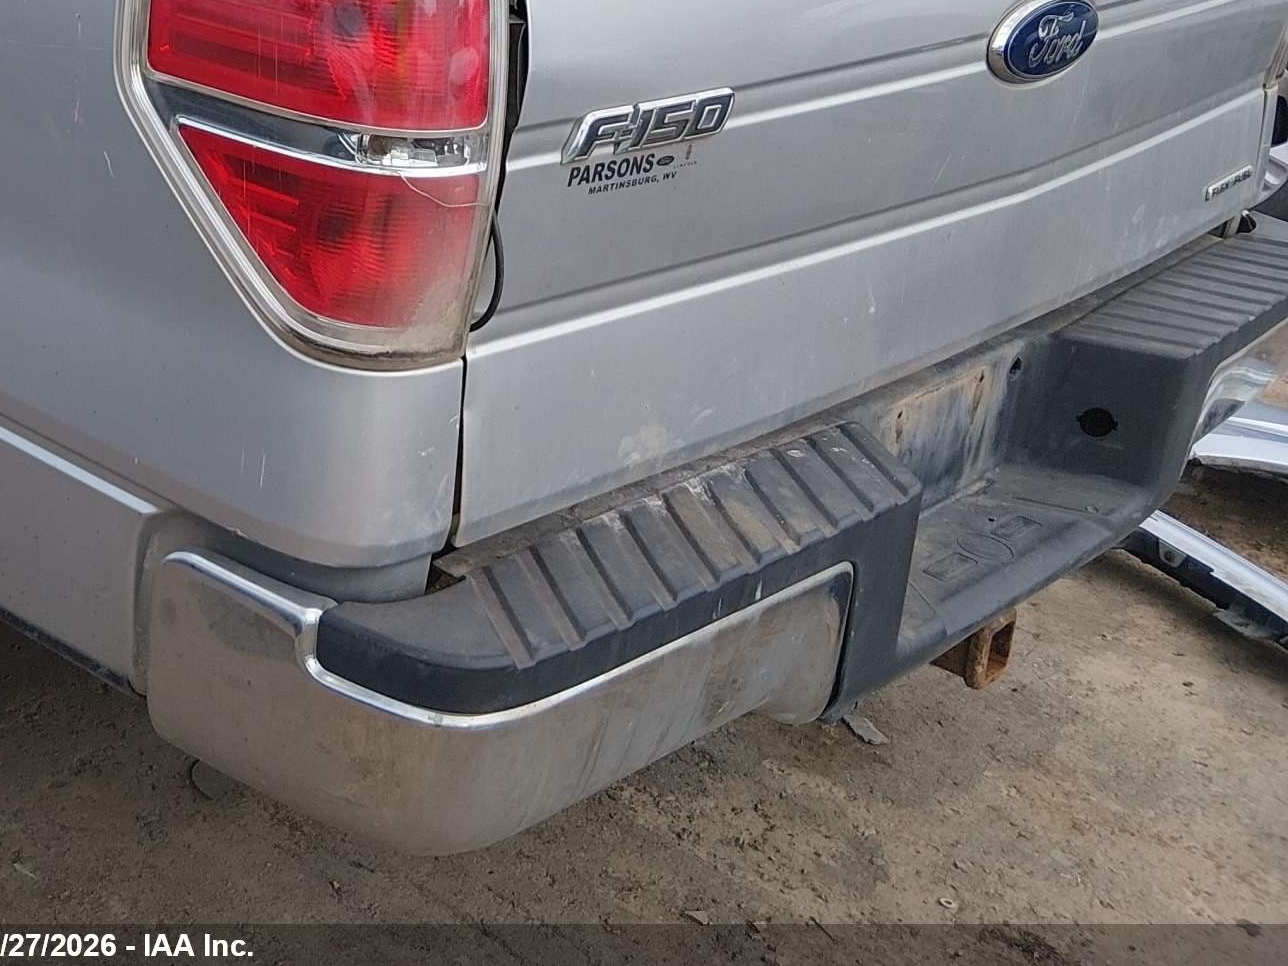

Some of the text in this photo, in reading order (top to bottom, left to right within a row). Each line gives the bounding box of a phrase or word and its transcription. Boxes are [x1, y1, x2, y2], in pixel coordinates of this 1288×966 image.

[1028, 11, 1087, 68] Ford
[561, 87, 736, 165] F-150
[567, 152, 656, 187] PARSONS
[587, 170, 678, 195] MARTINSBURG, WV
